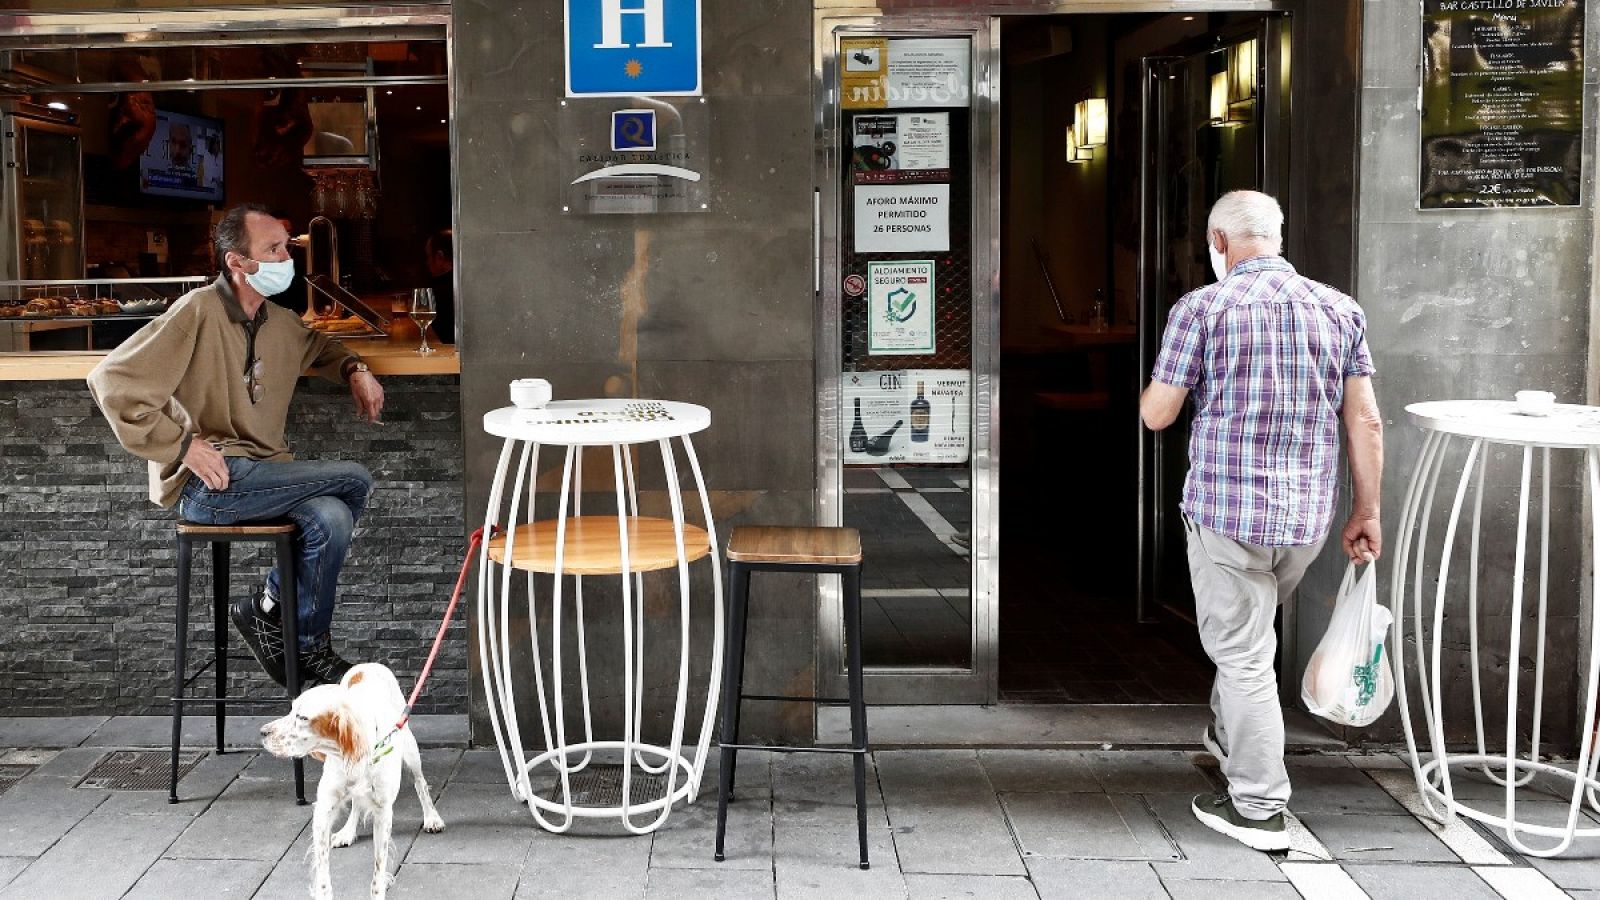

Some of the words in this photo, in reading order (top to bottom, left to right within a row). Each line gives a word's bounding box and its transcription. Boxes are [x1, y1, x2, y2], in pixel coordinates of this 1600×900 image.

[1460, 0, 1513, 10] CASTILLO
[593, 0, 673, 48] H
[866, 196, 897, 206] AFORO
[899, 194, 938, 205] MÁXIMO
[878, 210, 927, 219] PERMITIDO
[872, 224, 884, 233] 26
[886, 224, 931, 233] PERSONAS
[874, 266, 928, 275] ALOJAMIENTO
[874, 276, 906, 285] SEGURO
[879, 374, 903, 390] GIN
